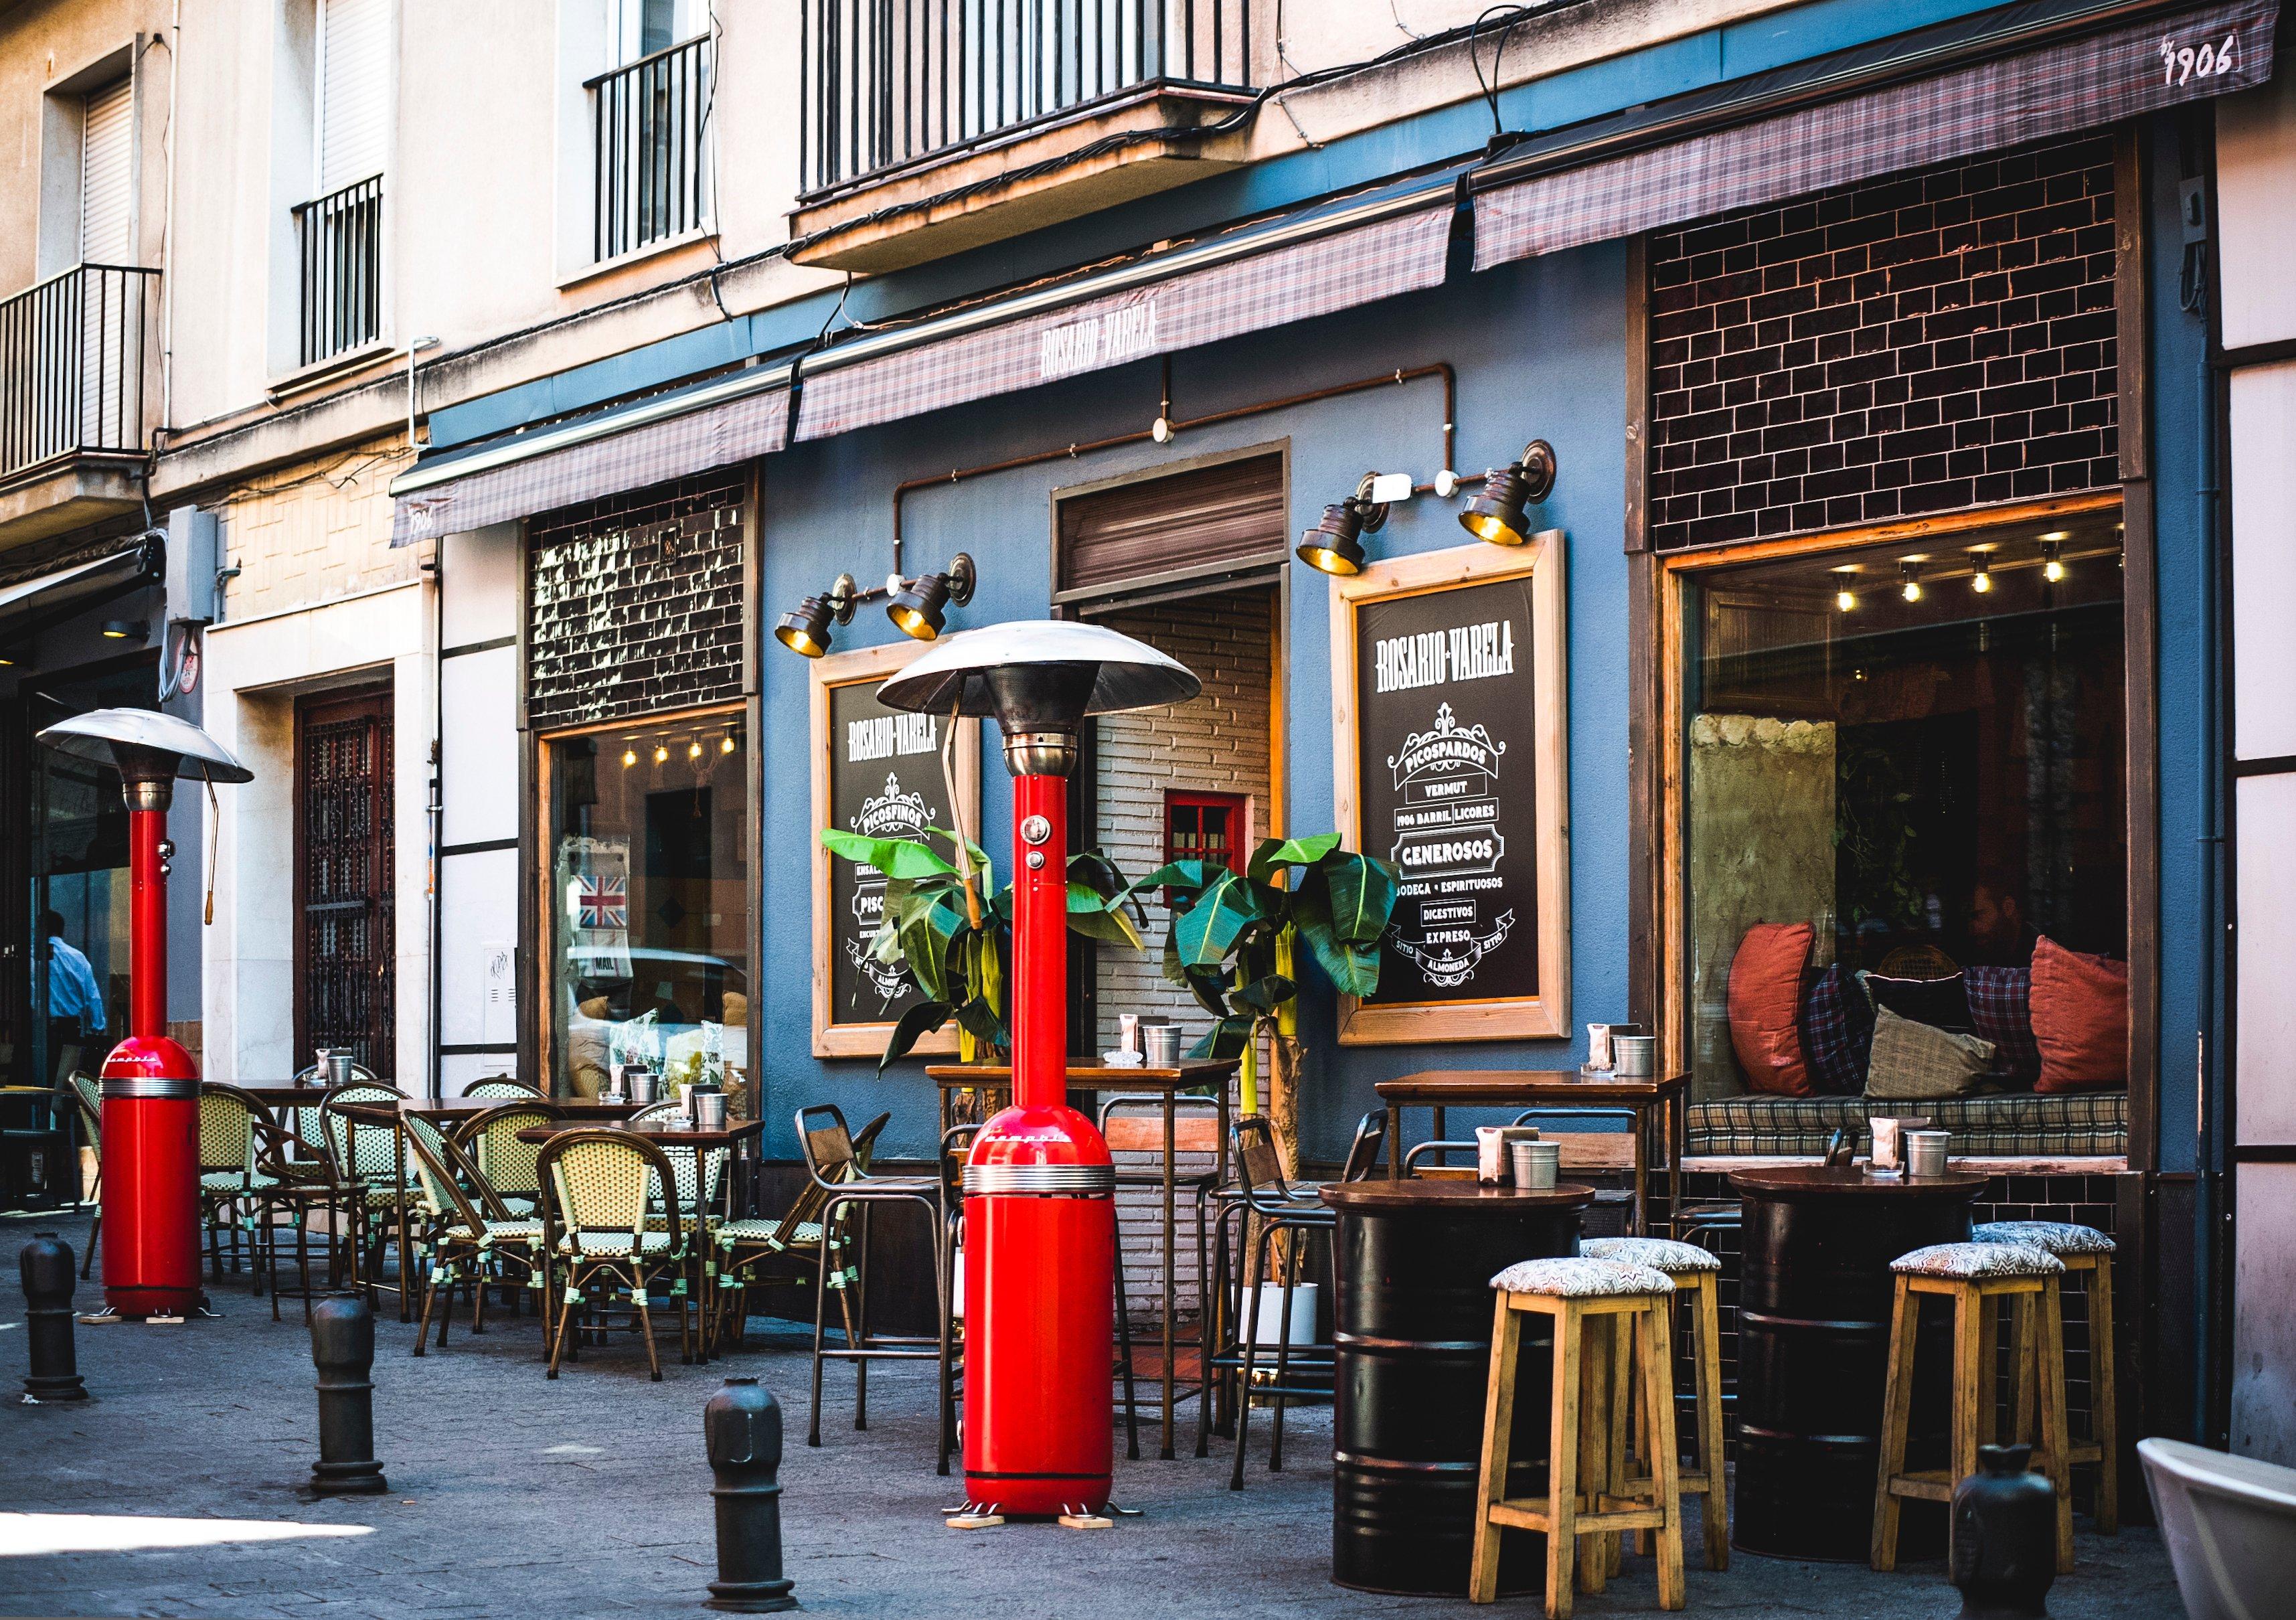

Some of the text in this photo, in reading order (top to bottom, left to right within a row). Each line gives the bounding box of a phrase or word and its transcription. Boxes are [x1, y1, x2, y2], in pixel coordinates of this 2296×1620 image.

[2165, 35, 2234, 86] 1906
[1040, 301, 1161, 378] ROSARIO VARELA
[1376, 620, 1514, 693] ROSARIO VARELA
[848, 712, 937, 762] ROSARIO VARELA
[1405, 741, 1487, 773] PICOSPARDOS
[1424, 781, 1467, 798] VERMUT
[863, 804, 922, 833] PICOSFINOS
[1397, 810, 1452, 827] 1906 BARRIL
[1455, 805, 1495, 821] LICORES
[1441, 877, 1503, 892] ESPIRITUOSOS
[1426, 929, 1471, 944] EXPRESO
[1484, 932, 1503, 949] SITIO
[1396, 941, 1414, 954] SITIO
[596, 957, 614, 970] MAIL
[1427, 958, 1470, 973] ALMONEDA
